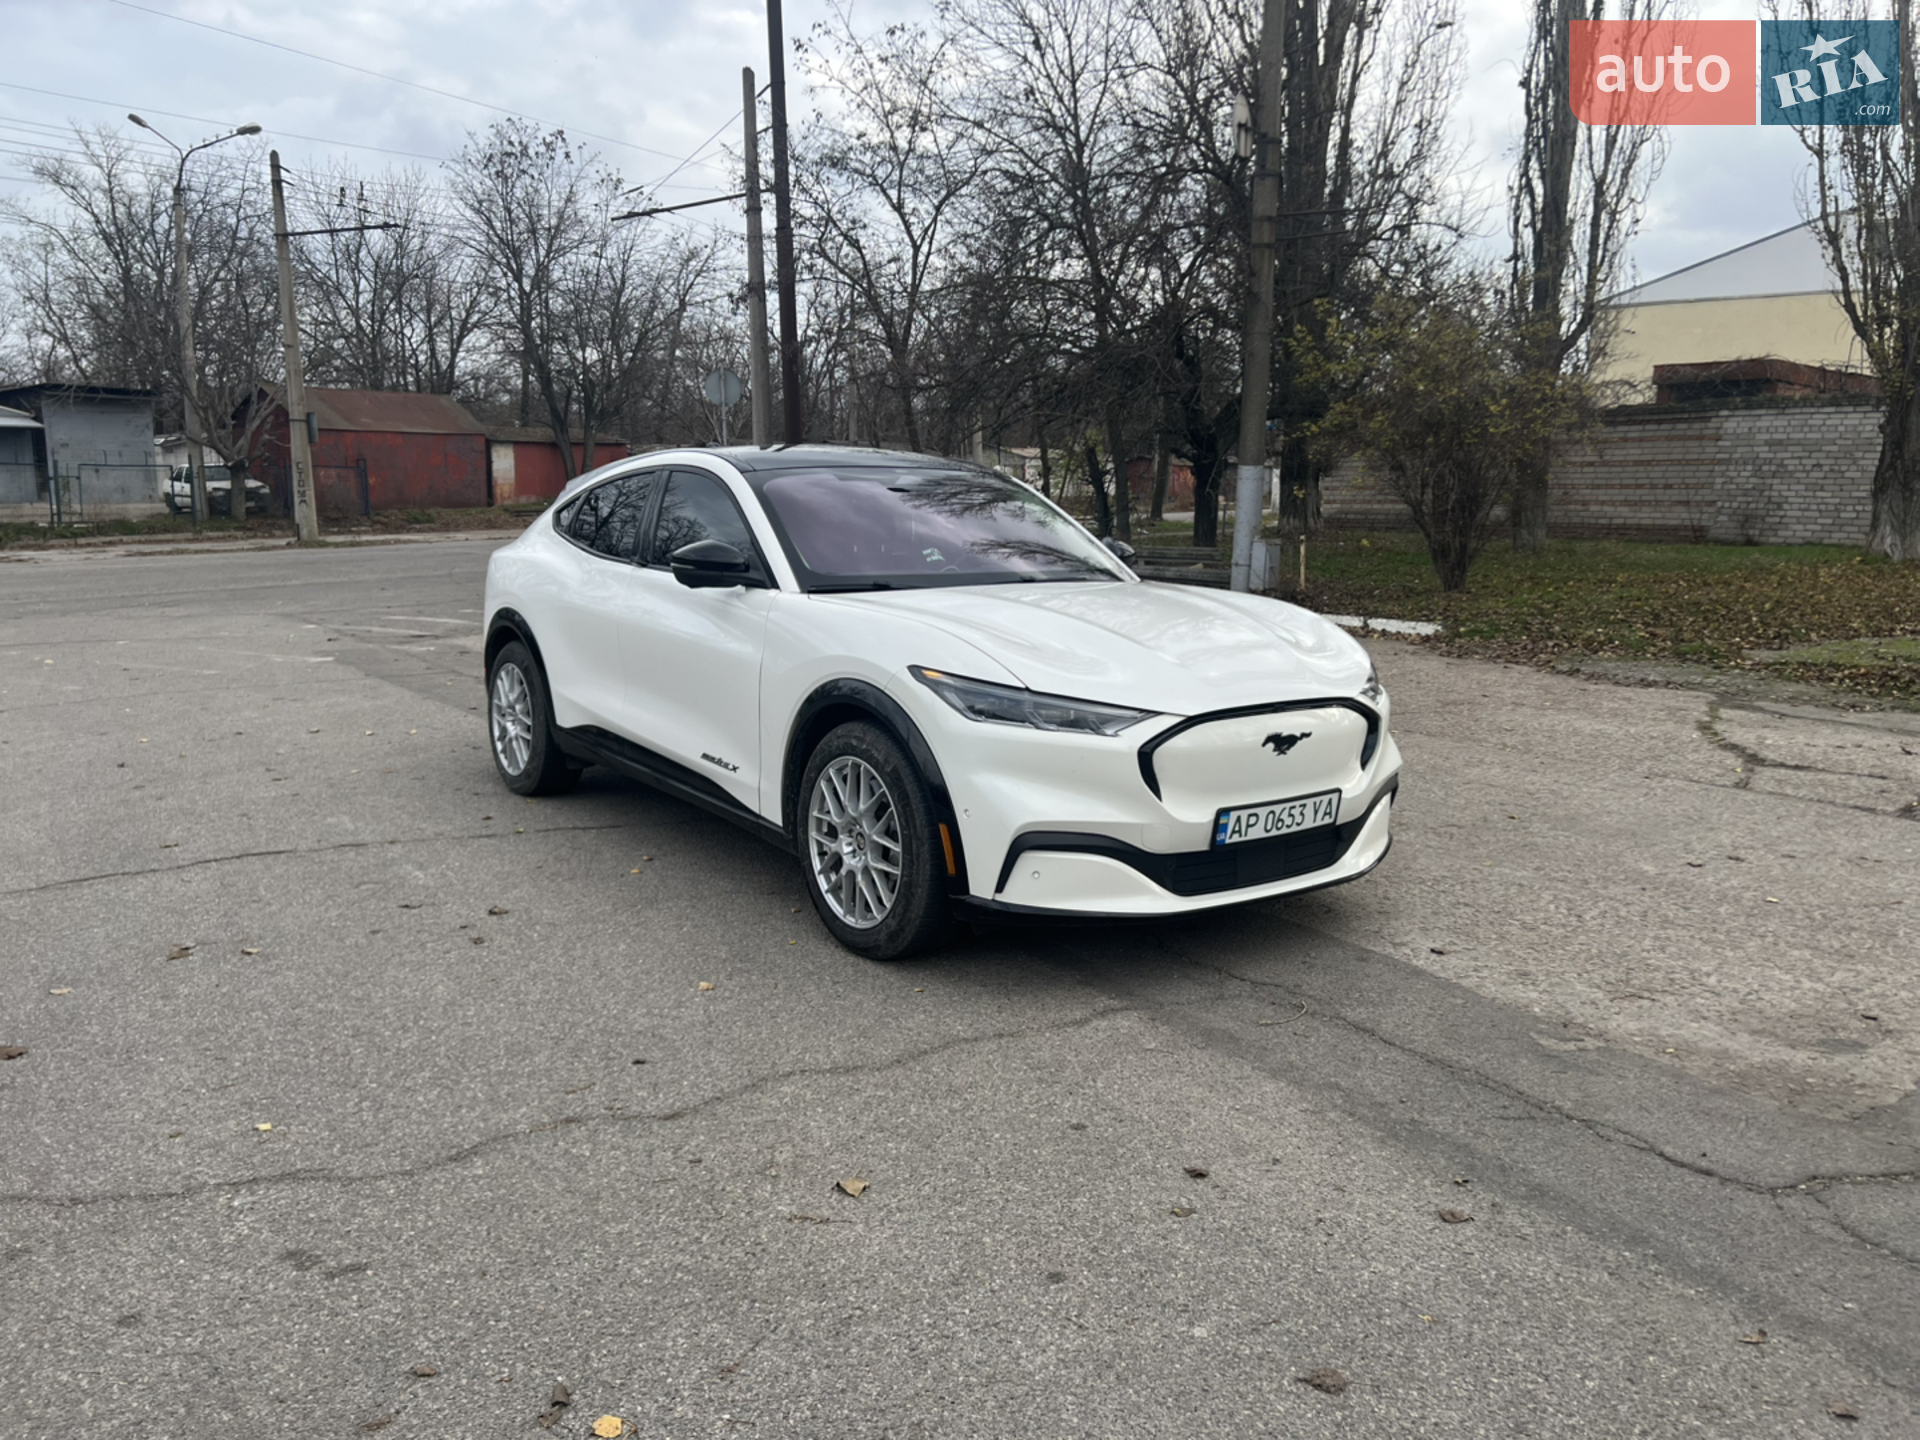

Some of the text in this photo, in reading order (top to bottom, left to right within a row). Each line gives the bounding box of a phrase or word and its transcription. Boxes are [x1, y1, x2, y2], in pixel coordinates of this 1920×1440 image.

[1228, 797, 1333, 840] AP 0653 YA
